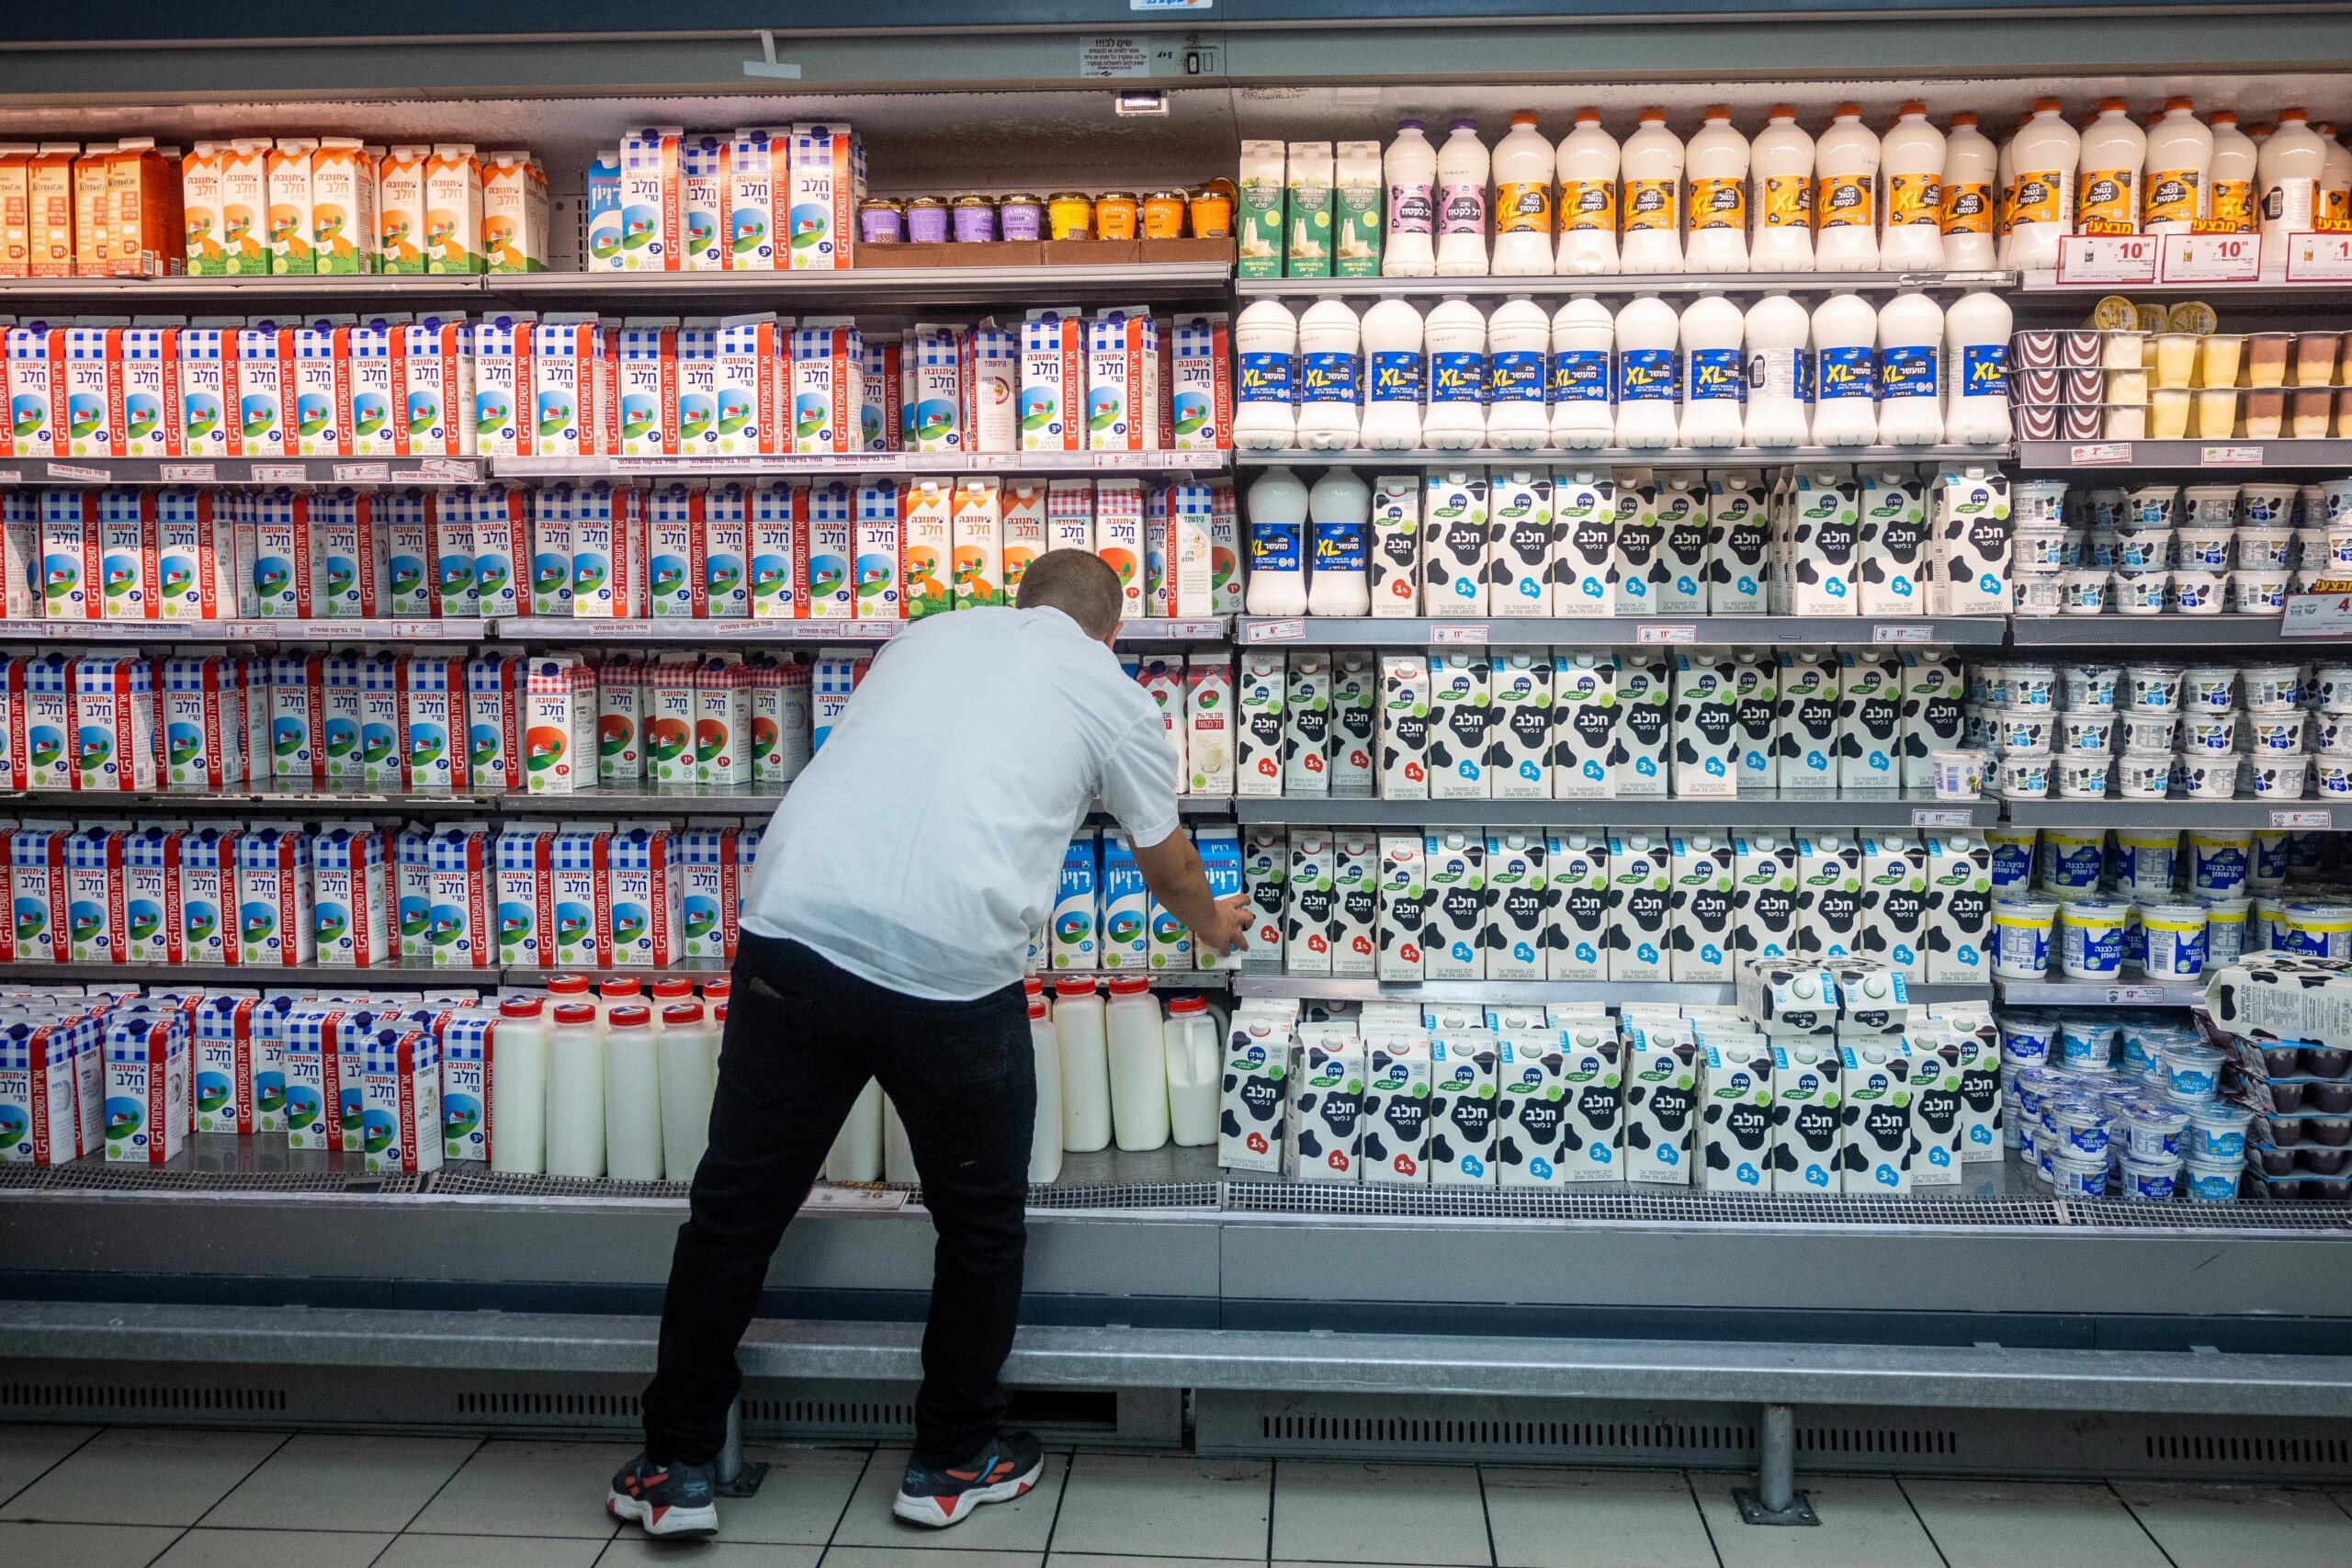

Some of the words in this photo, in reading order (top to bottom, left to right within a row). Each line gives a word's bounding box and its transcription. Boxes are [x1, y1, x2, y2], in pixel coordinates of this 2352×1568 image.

[1117, 39, 1132, 47] שים
[196, 185, 217, 196] חלב
[632, 180, 658, 194] חלב
[1498, 199, 1523, 219] XL
[2088, 220, 2133, 235] מבצע!
[2193, 219, 2236, 232] מבצע!
[2317, 217, 2352, 231] בצע!
[2120, 243, 2143, 258] 10
[2218, 242, 2241, 257] 10
[20, 369, 45, 383] חלב
[727, 365, 753, 378] חלב
[1883, 365, 1901, 384] XL
[1242, 369, 1267, 387] XL
[1452, 498, 1465, 506] טרה
[1111, 525, 1135, 537] חלב
[52, 531, 79, 545] חלב
[1452, 532, 1480, 543] חלב
[1387, 539, 1411, 549] חלב
[1396, 584, 1408, 594] 1%
[1458, 582, 1472, 592] 3%
[2337, 597, 2350, 611] 4
[539, 704, 564, 716] חלב
[1254, 719, 1277, 728] חלב
[438, 882, 464, 895] חלב
[1304, 895, 1327, 907] חלב
[1448, 897, 1476, 908] חלב
[1310, 939, 1324, 949] 1%
[1455, 948, 1470, 958] 3%
[116, 1073, 144, 1086] חלב
[1327, 1101, 1355, 1113] חלב
[1871, 1113, 1902, 1127] חלב
[1332, 1156, 1345, 1166] 1%
[1880, 1169, 1895, 1179] 3%
